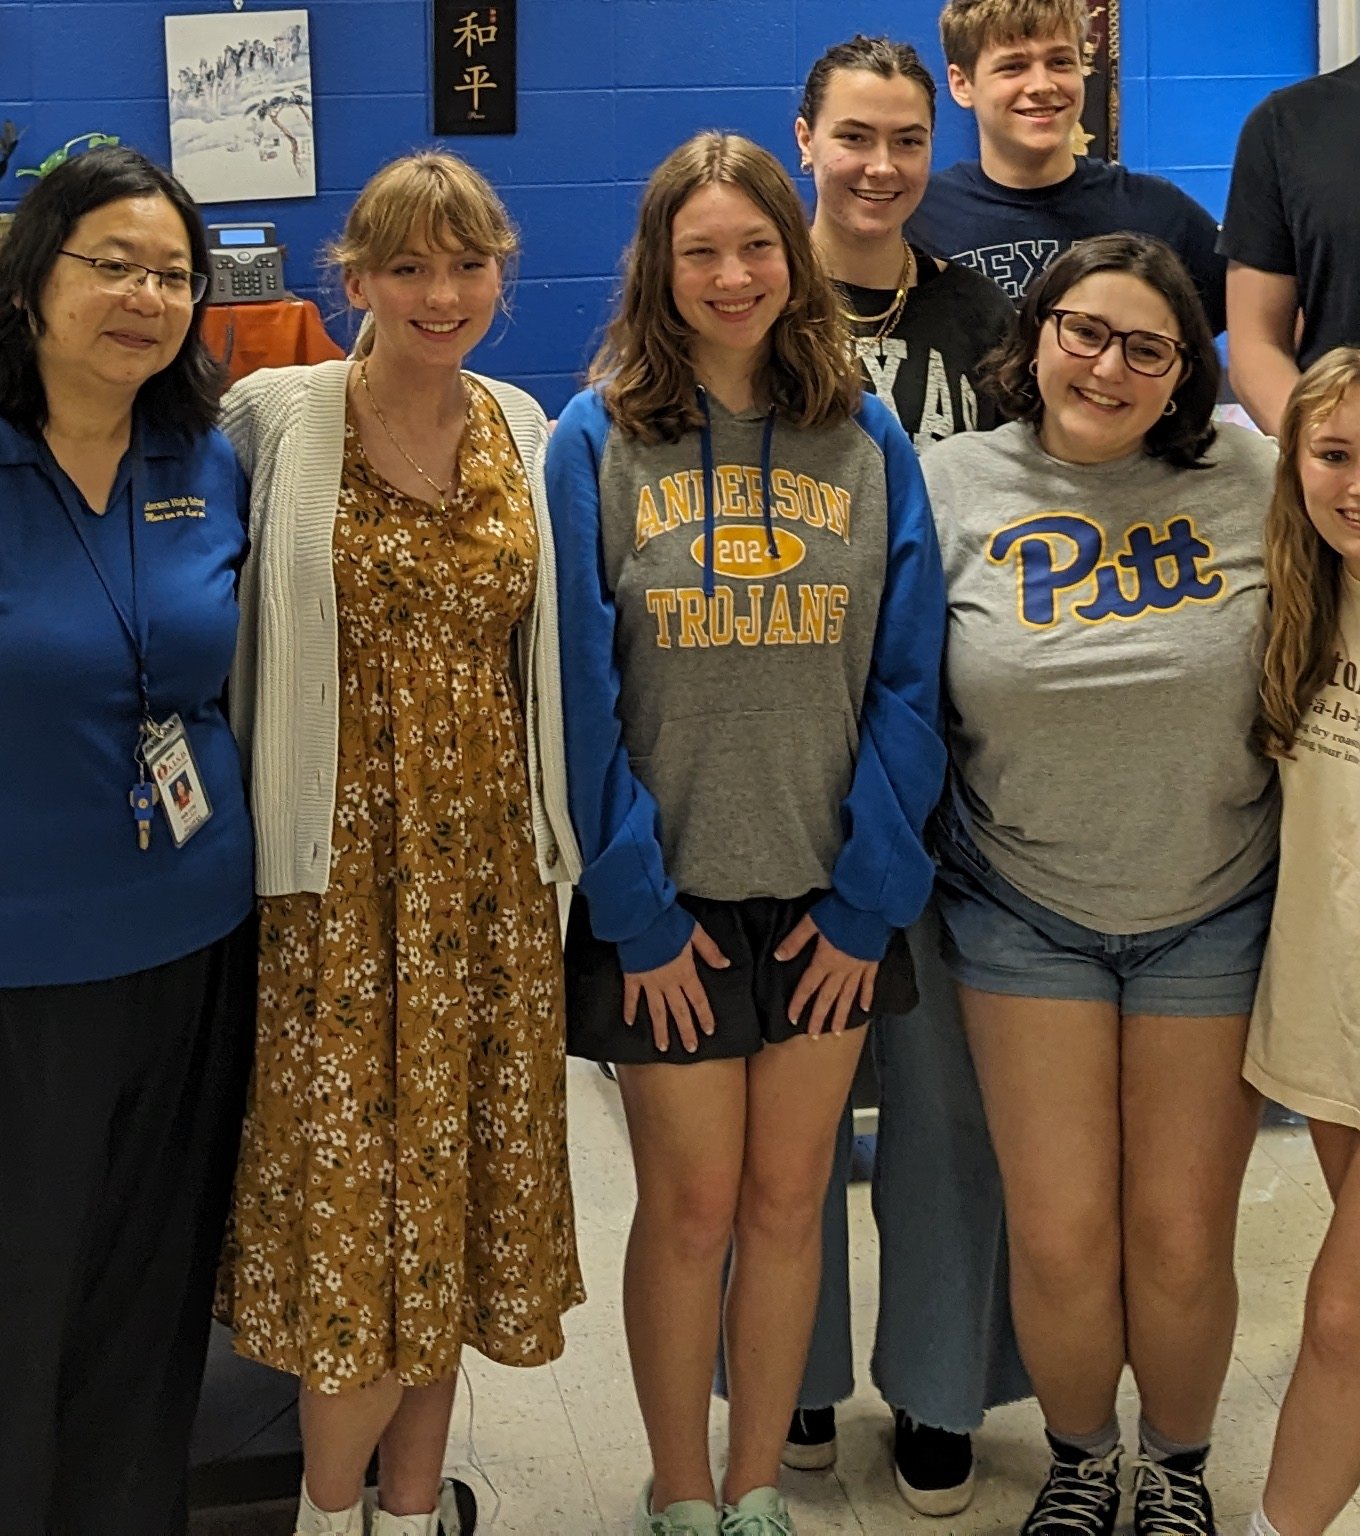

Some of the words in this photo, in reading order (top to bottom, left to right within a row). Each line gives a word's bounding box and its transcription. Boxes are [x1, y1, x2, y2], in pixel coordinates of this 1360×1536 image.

[453, 11, 498, 111] 和平
[634, 465, 851, 550] ANDERSON
[985, 510, 1224, 630] Pitt
[646, 585, 849, 649] TROJANS
